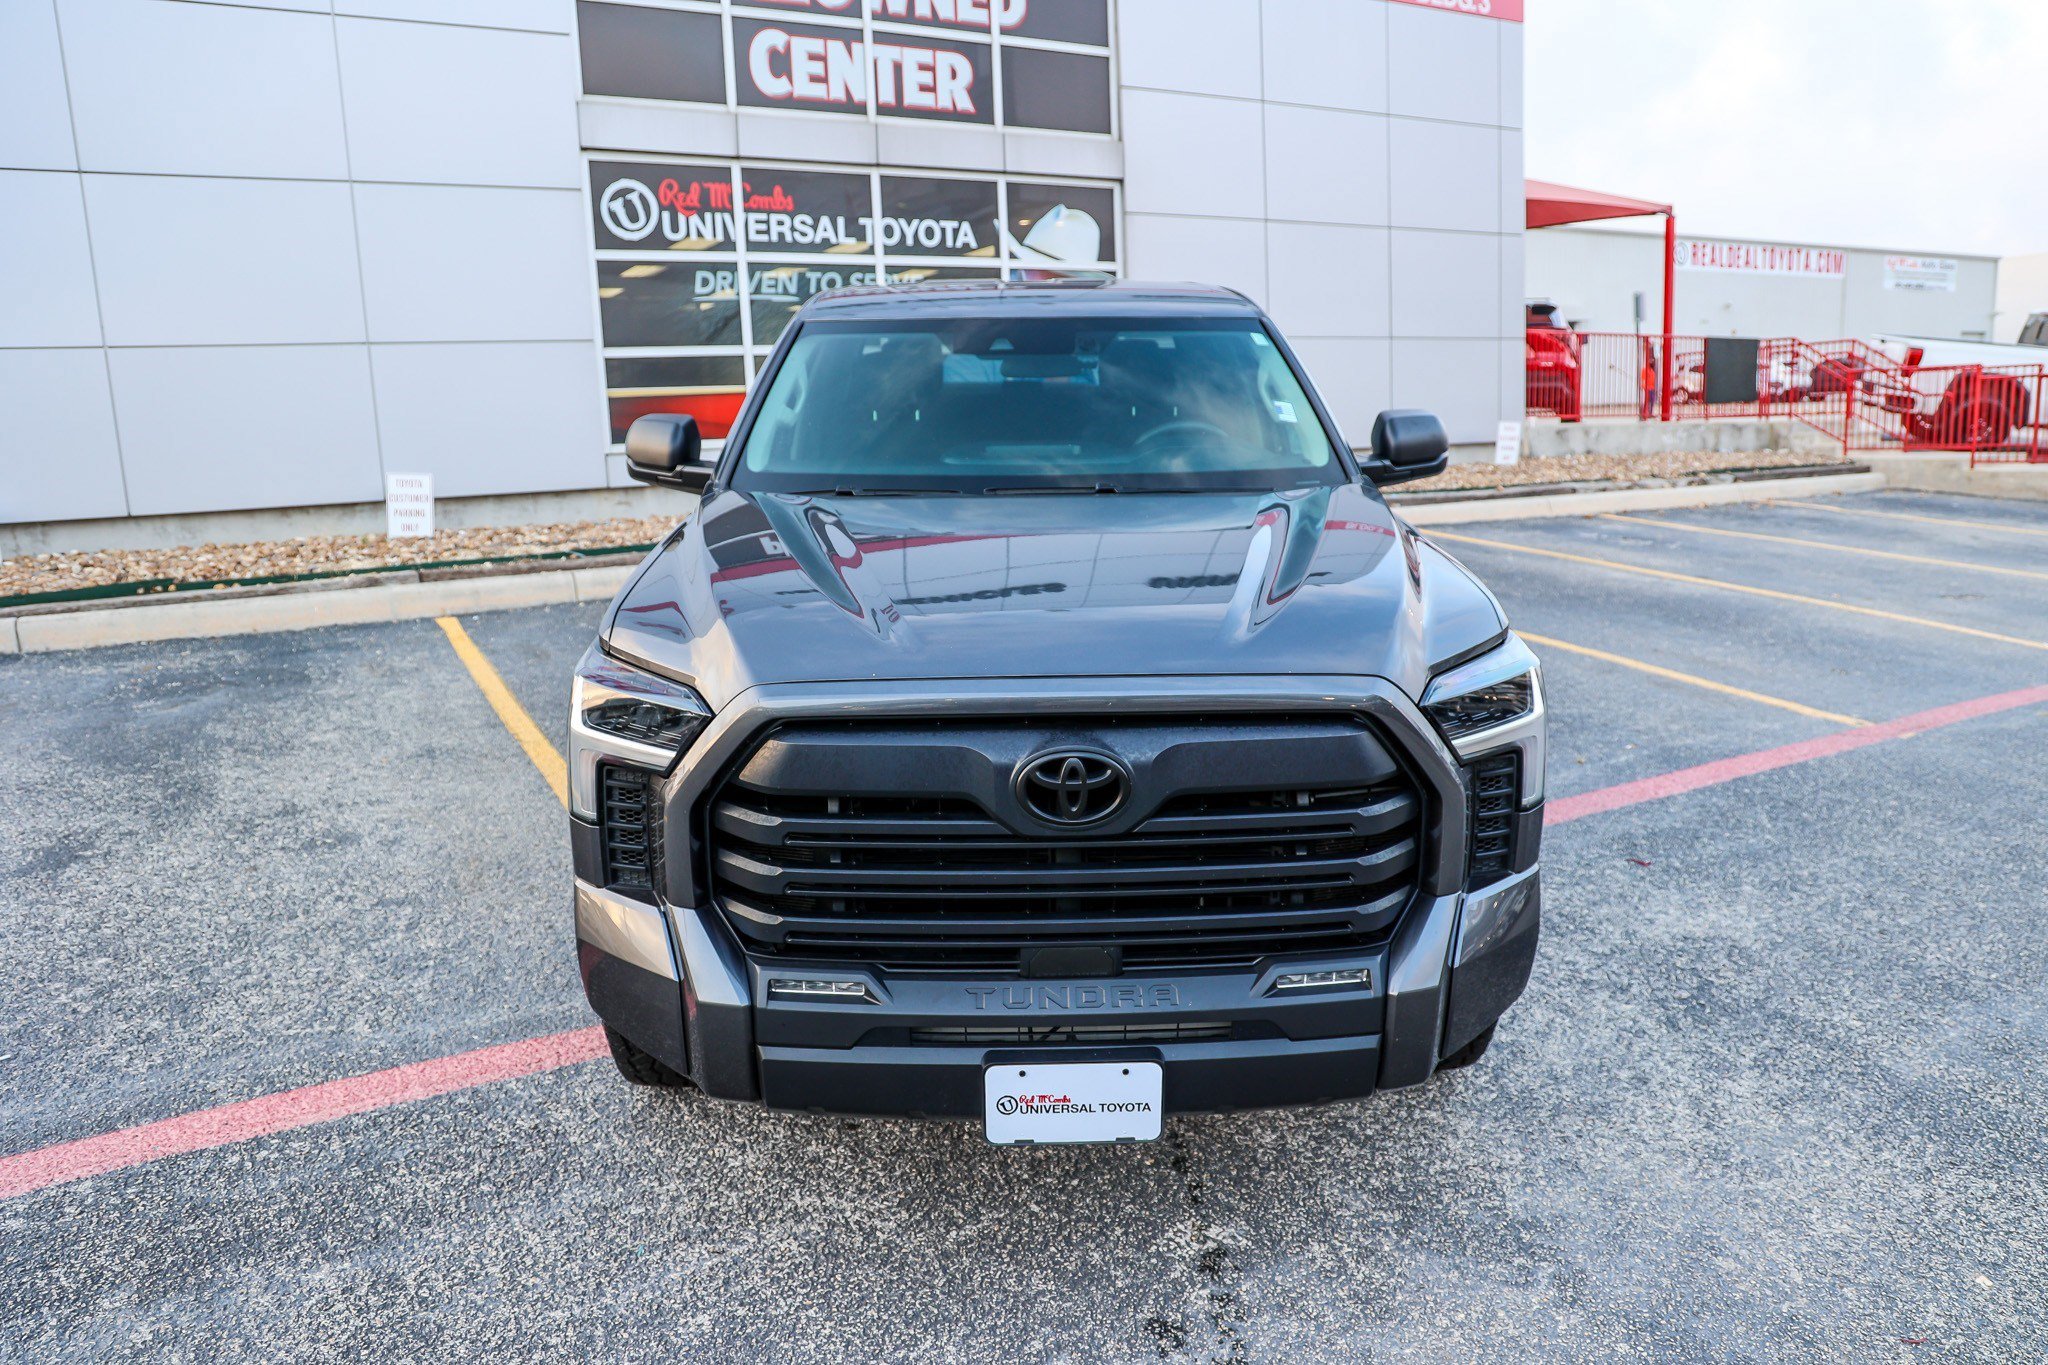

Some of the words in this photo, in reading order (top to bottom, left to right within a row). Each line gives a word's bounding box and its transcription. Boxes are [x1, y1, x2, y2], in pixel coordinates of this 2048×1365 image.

[749, 27, 977, 115] CENTER
[658, 178, 701, 217] Red
[702, 181, 795, 212] MCombs
[661, 210, 858, 245] UNIVERSAL
[857, 216, 979, 249] TOYOTA
[805, 271, 843, 294] TO
[964, 983, 1180, 1010] TUNDRA
[1019, 1094, 1036, 1107] Red
[1020, 1103, 1096, 1114] UNIVERSAL
[1098, 1102, 1151, 1112] TOYOTA
